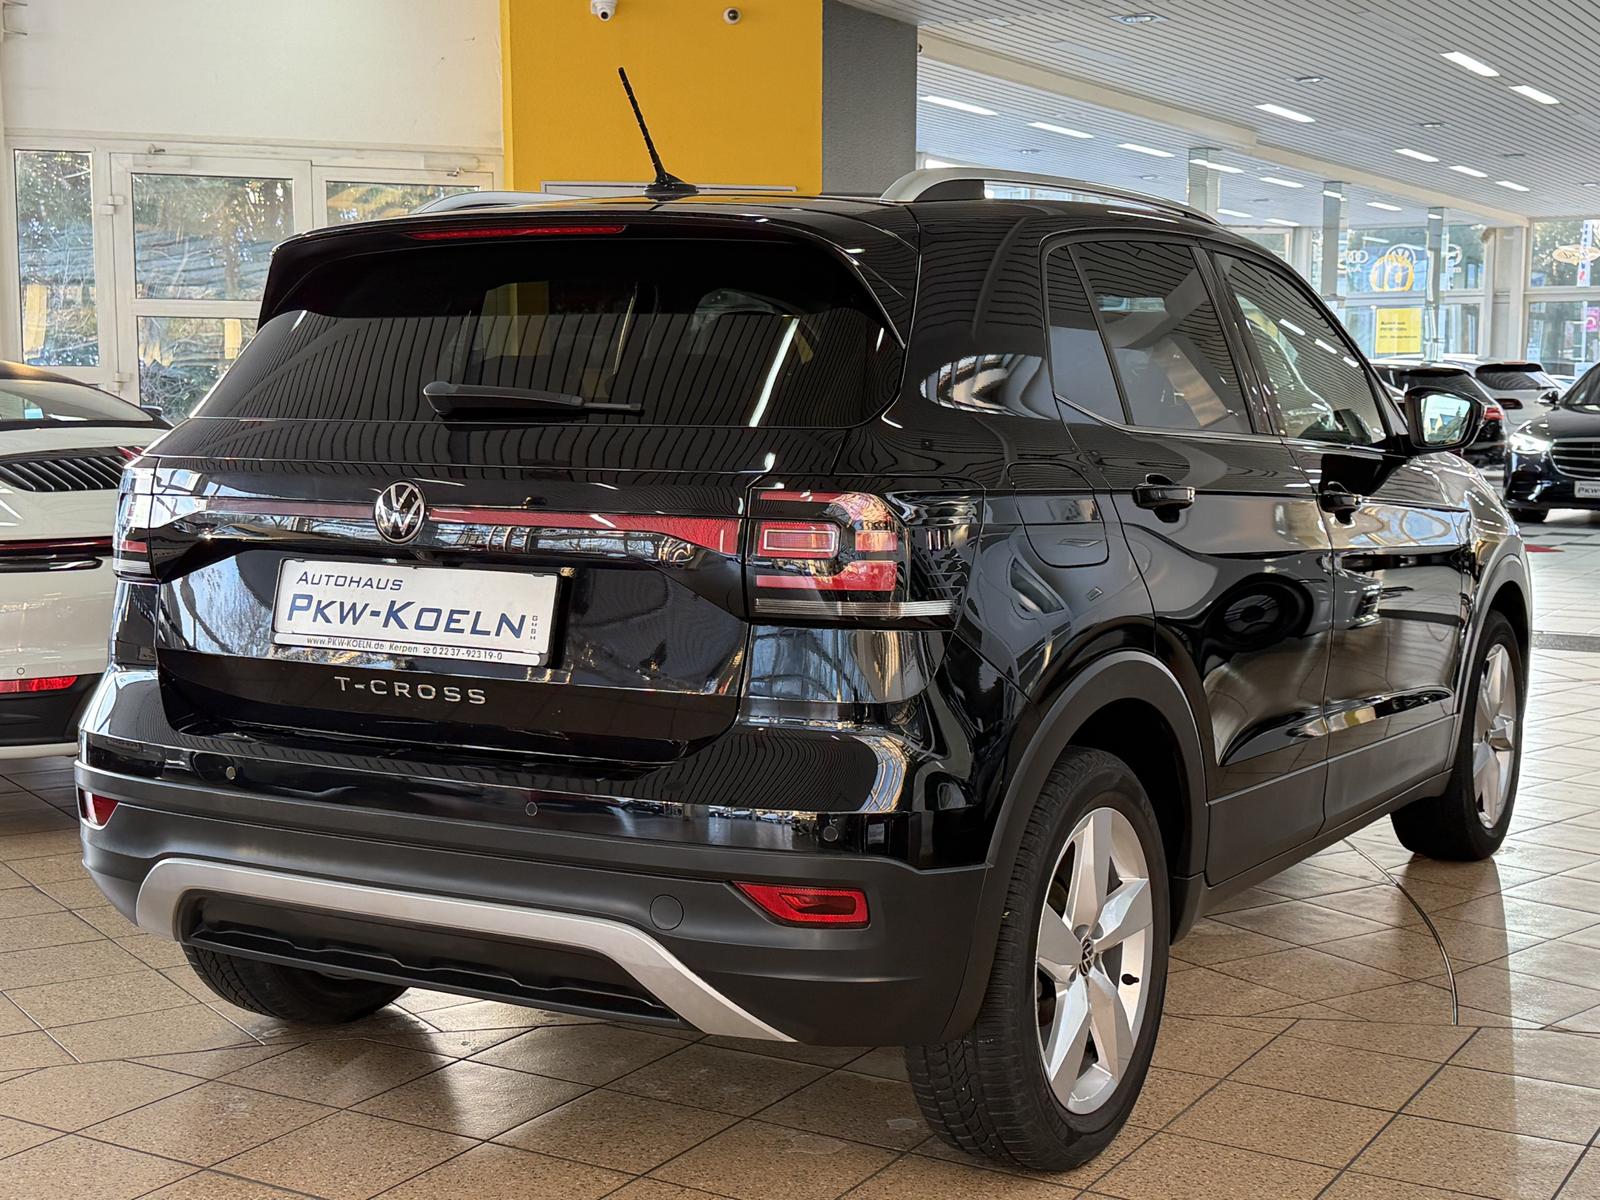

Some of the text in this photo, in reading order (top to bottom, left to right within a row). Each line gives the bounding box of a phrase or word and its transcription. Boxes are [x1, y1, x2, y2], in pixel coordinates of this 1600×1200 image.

[296, 571, 403, 590] AUTOHAUS
[287, 593, 526, 637] PKW-KOELN
[306, 637, 385, 650] www.PKW-KOELN.de
[389, 643, 418, 653] Kerpen
[334, 676, 486, 704] T-CROSS
